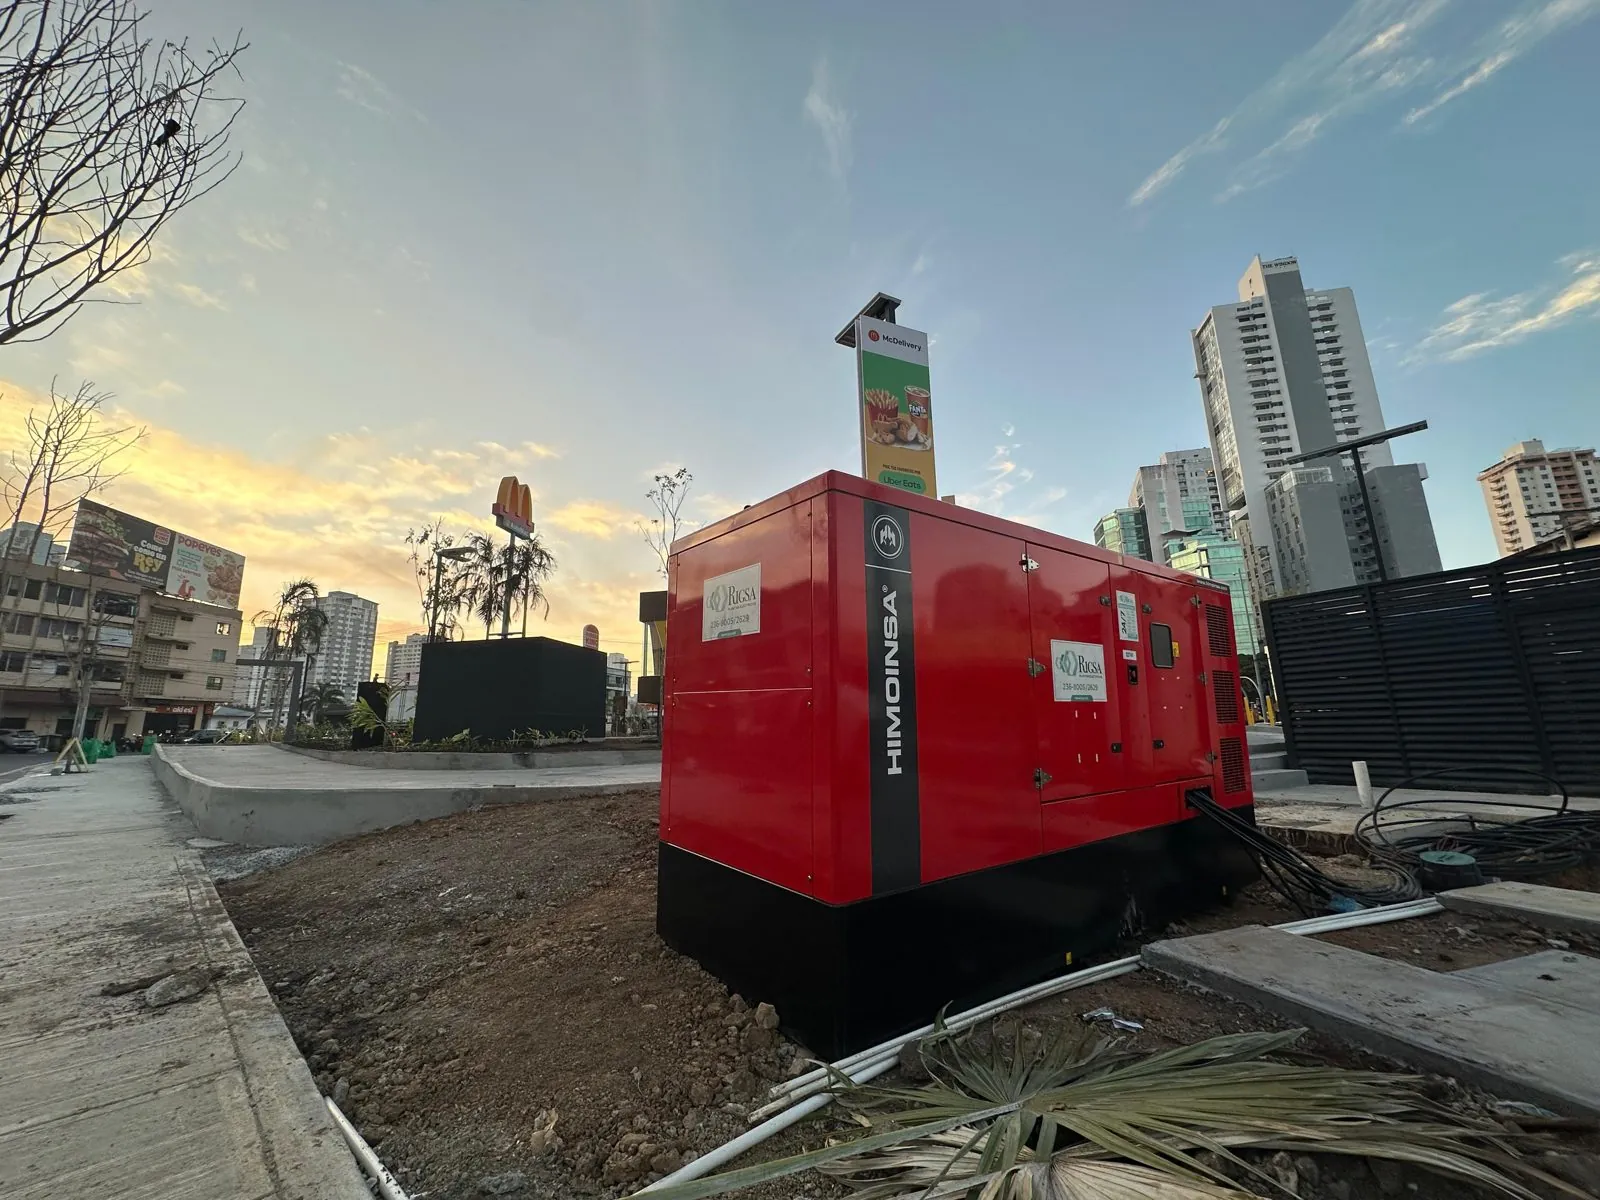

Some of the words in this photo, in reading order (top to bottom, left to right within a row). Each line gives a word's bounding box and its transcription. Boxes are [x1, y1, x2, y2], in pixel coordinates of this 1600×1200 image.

[882, 334, 922, 351] McDelivery
[883, 475, 901, 486] Uber
[903, 479, 922, 490] Eats
[133, 545, 156, 557] como
[155, 552, 167, 561] un
[140, 540, 163, 552] Come
[133, 552, 164, 573] Rey
[883, 589, 903, 775] HIMOINSA
